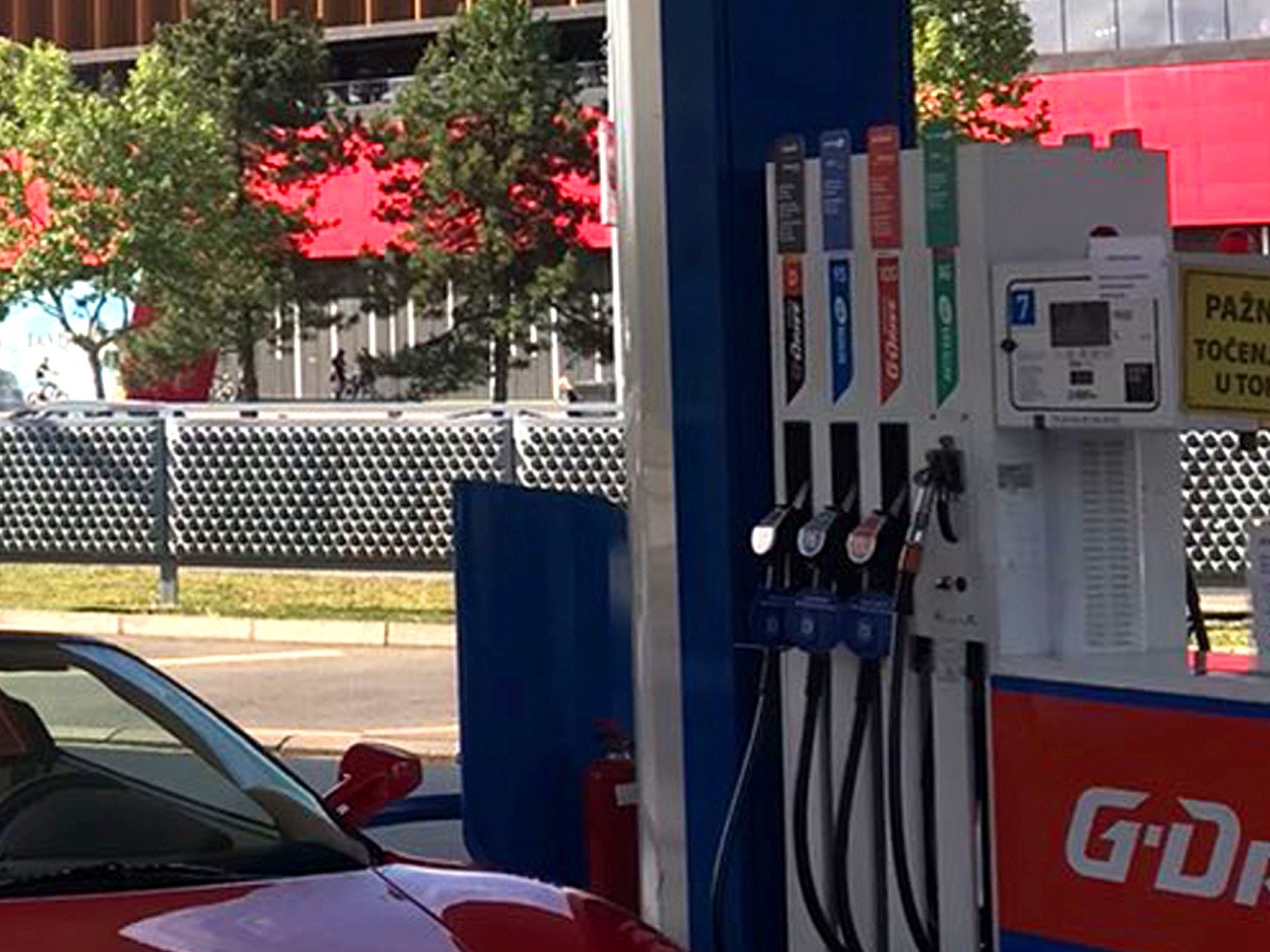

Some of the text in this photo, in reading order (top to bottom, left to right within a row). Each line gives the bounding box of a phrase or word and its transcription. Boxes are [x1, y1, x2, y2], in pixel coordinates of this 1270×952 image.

[1014, 293, 1029, 320] 7
[1193, 336, 1270, 365] TOČEN
[1215, 372, 1231, 394] U
